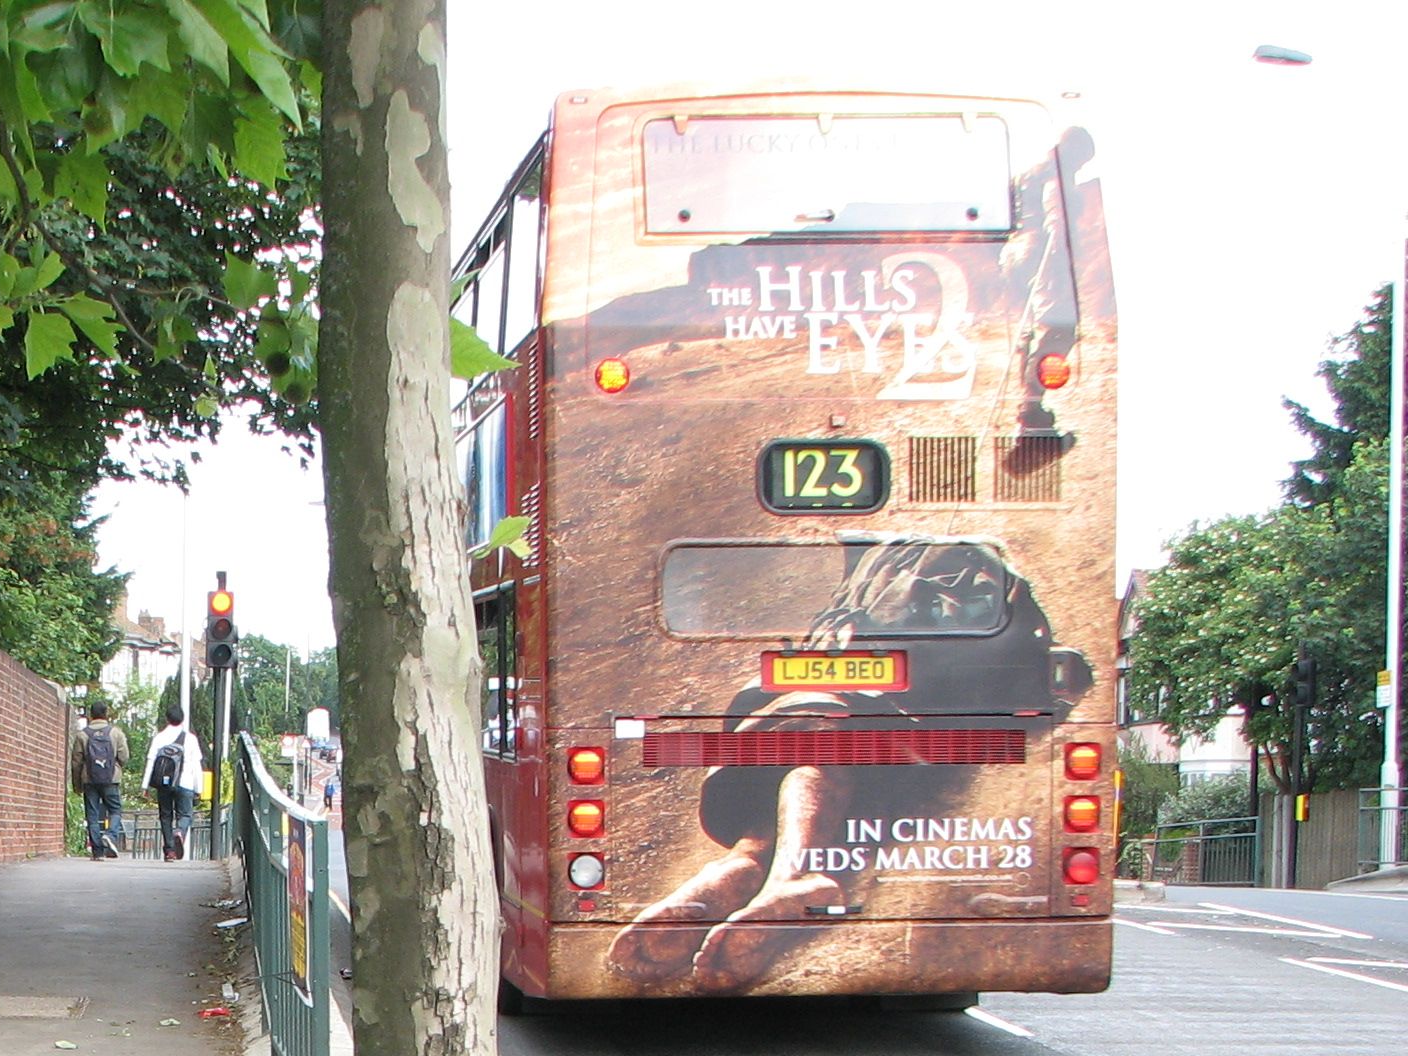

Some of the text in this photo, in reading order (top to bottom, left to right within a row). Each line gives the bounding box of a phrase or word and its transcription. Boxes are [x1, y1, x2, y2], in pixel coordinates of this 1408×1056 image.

[706, 265, 917, 312] THE HILLS
[724, 311, 976, 374] HAVE EYES
[784, 449, 863, 497] 123
[782, 661, 837, 680] LJ54
[846, 816, 1032, 843] IN CINEMAS
[875, 844, 990, 870] MARCH
[998, 844, 1032, 869] 28
